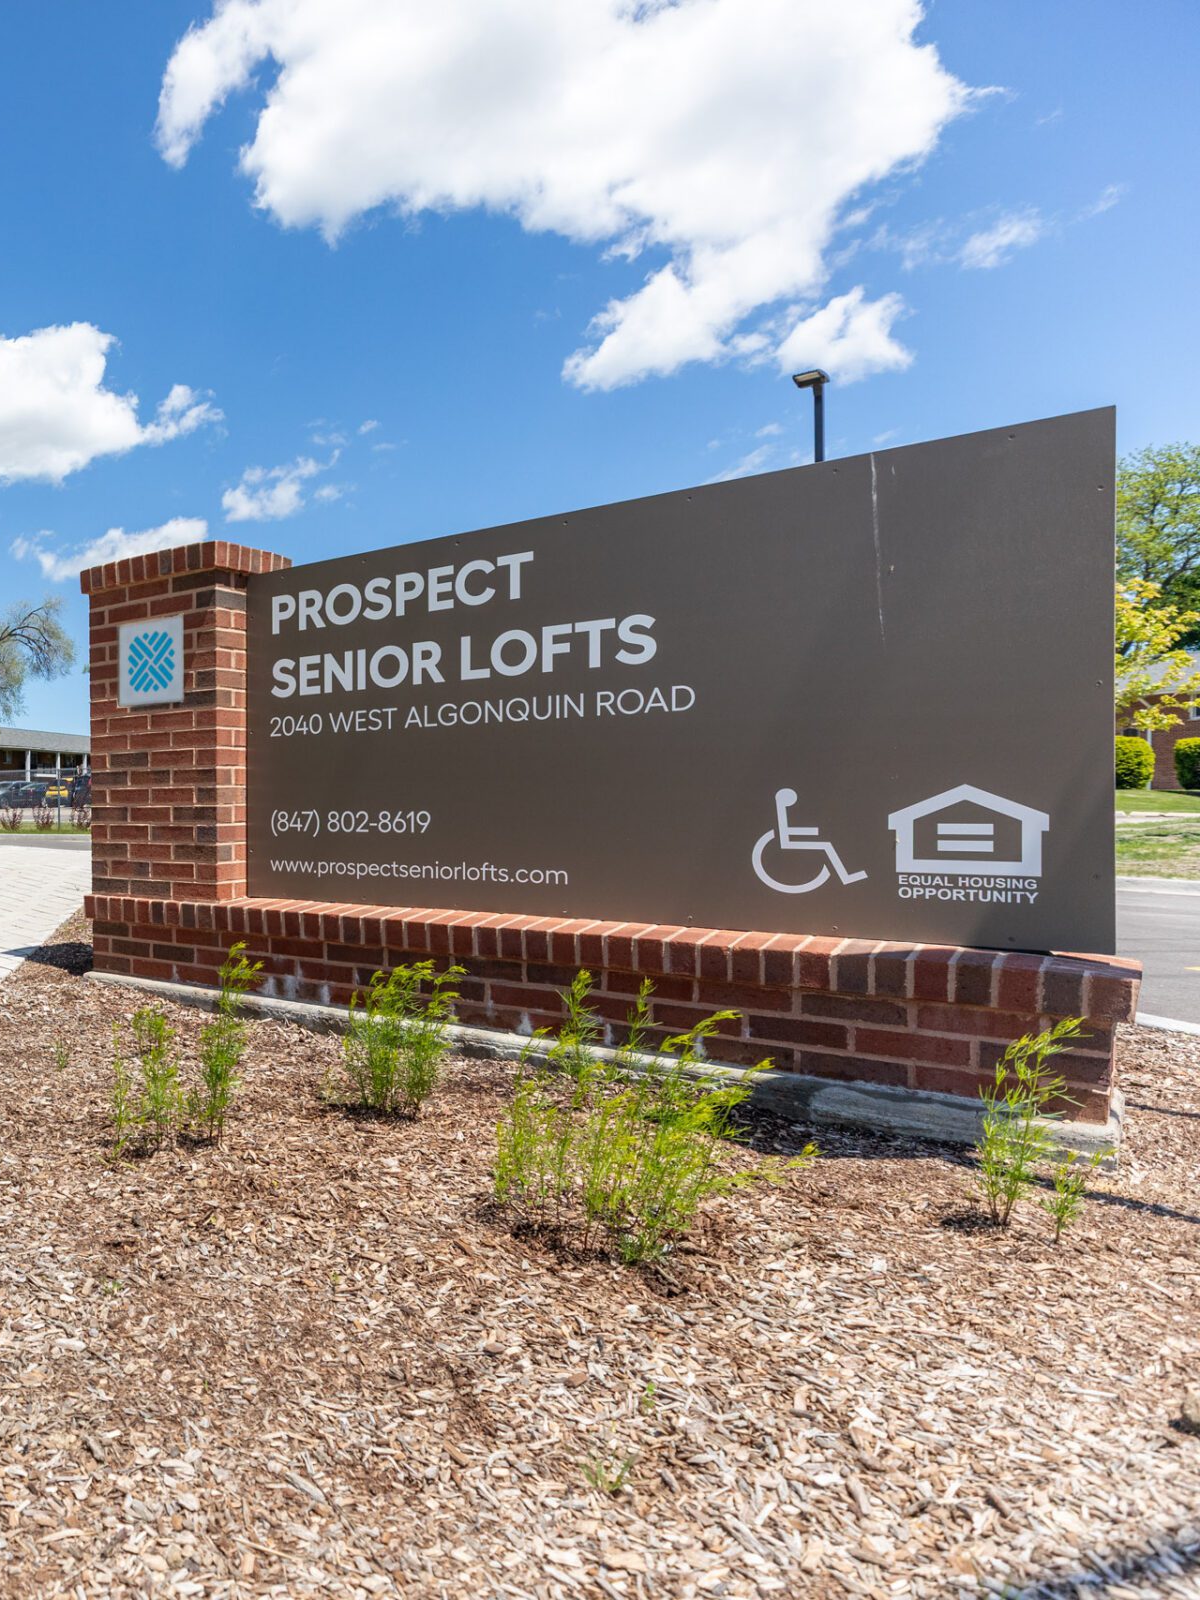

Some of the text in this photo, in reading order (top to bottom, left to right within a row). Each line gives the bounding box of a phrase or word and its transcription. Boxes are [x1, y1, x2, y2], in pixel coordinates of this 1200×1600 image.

[271, 550, 534, 635] PROSPECT
[270, 613, 658, 699] SENIOR LOFTS
[270, 684, 696, 738] 2040 WEST ALGONQUIN ROAD
[270, 809, 432, 838] (847) 802-8619
[270, 859, 569, 886] www.prospectseniorlofts.com
[898, 874, 1038, 890] EQUAL HOUSING
[897, 886, 1039, 904] OPPORTUNITY
